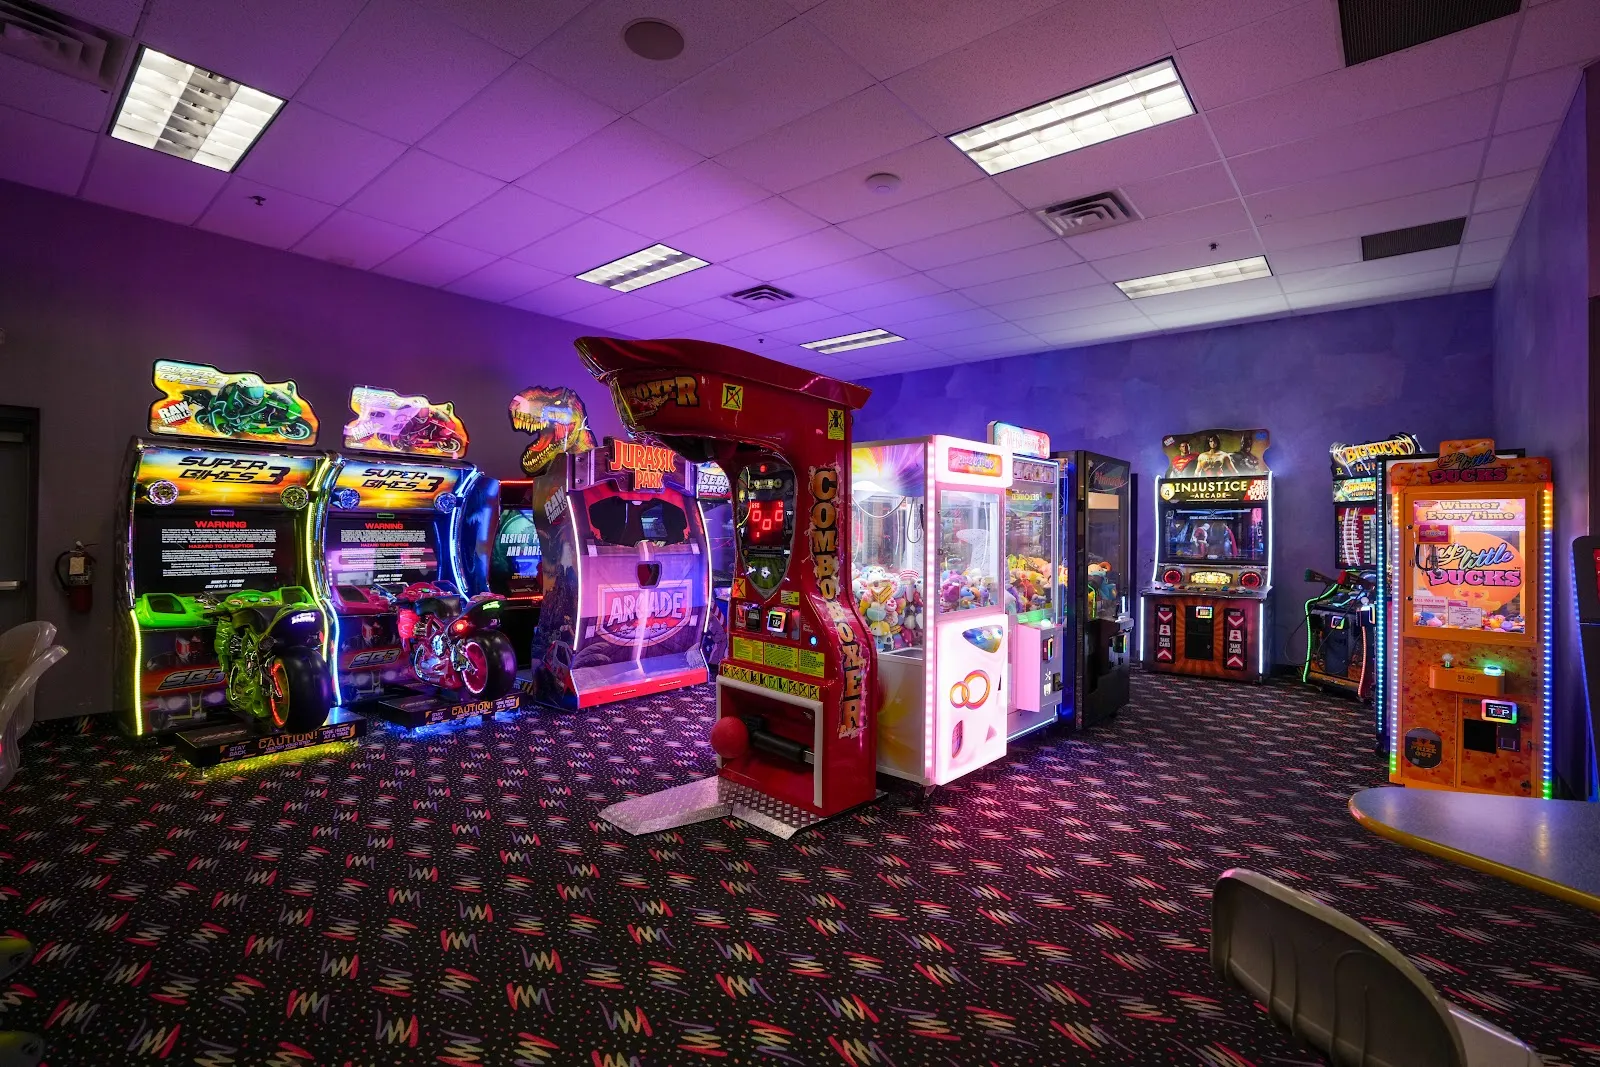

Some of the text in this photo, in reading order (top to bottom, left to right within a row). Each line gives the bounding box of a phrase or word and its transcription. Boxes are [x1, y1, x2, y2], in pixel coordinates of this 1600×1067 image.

[157, 401, 190, 420] RAW
[610, 439, 676, 472] JURASSIC
[1345, 441, 1405, 464] BIG BUCK
[178, 456, 268, 470] SUPER
[178, 466, 291, 484] BIKES 3
[362, 468, 427, 480] SUPER
[634, 469, 664, 490] PARK
[1428, 468, 1507, 484] DUCKS
[362, 476, 444, 492] BIKES 3
[1174, 481, 1248, 493] INJUSTICE
[544, 486, 565, 516] RAW
[1440, 501, 1500, 510] Winner
[547, 500, 568, 524] THRILLS
[1426, 510, 1516, 522] Every Time
[195, 520, 247, 529] WARNING
[365, 522, 404, 530] WARNING
[500, 533, 530, 544] RESTORE
[812, 469, 838, 600] COMBO
[506, 545, 542, 557] AND ORDE
[1458, 542, 1515, 570] little
[1426, 568, 1522, 587] DUCKS
[606, 591, 684, 627] ARCADE
[451, 701, 494, 716] CAUTION!
[258, 730, 318, 749] CAUTION!
[229, 744, 246, 752] STAY
[229, 749, 246, 757] BACK
[1410, 745, 1437, 754] PRIZE
[1414, 750, 1433, 759] OUT
